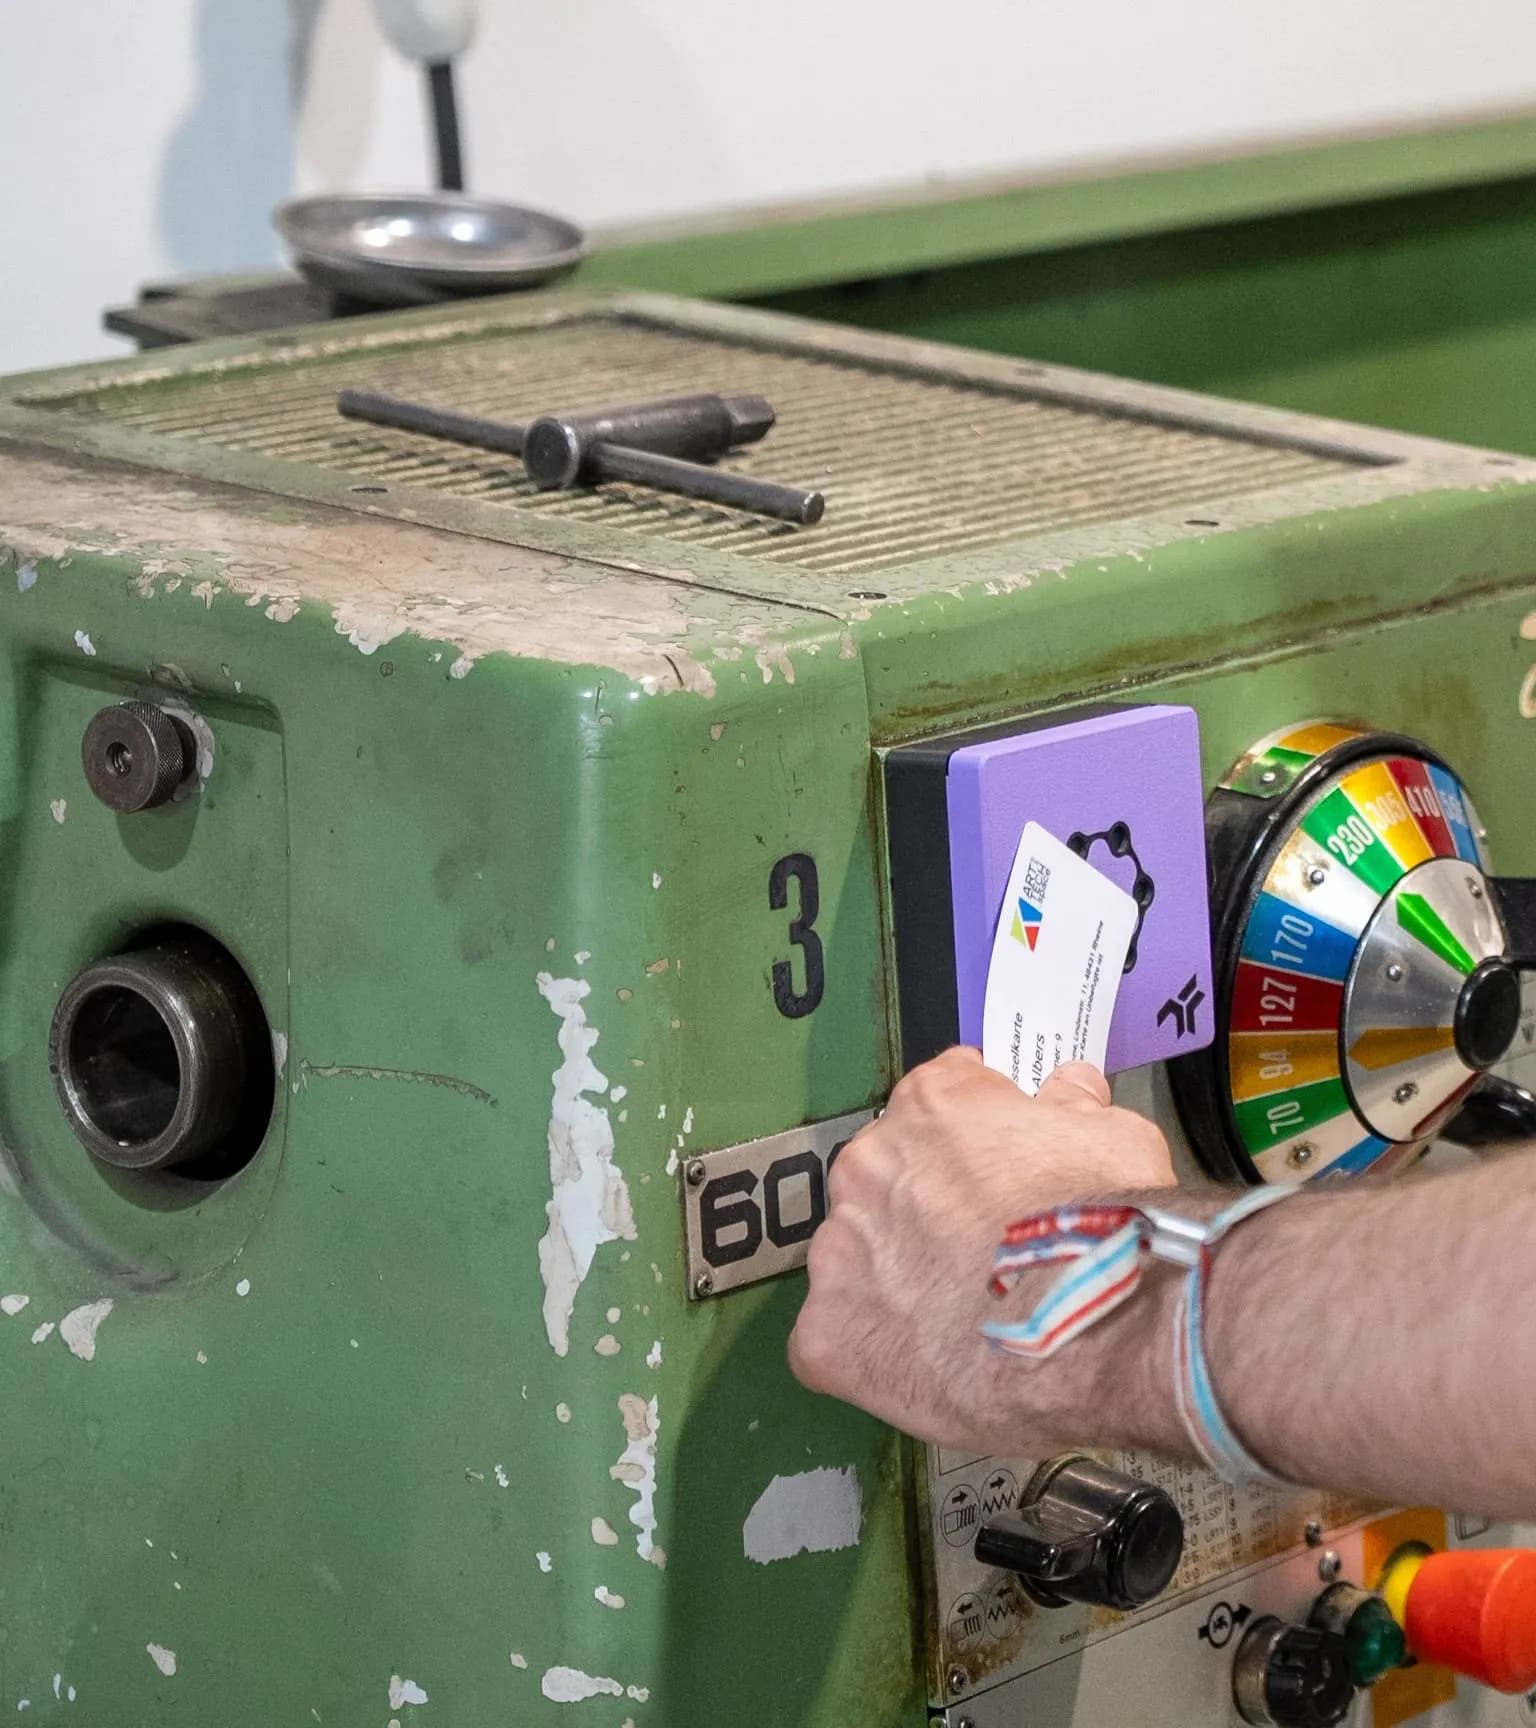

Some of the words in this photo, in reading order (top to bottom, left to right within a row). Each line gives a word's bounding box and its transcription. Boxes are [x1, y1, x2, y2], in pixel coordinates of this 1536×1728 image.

[1365, 791, 1408, 832] 305
[1404, 785, 1441, 818] 410
[1327, 815, 1375, 866] 230
[1023, 861, 1037, 899] ART
[1030, 863, 1046, 901] TECH
[1038, 868, 1051, 904] space
[768, 852, 825, 1019] 3
[1271, 913, 1314, 964] 170
[1259, 976, 1298, 1026] 127
[1012, 1011, 1023, 1083] sselkarte
[1032, 1032, 1045, 1089] Albers
[1258, 1048, 1294, 1080] 94
[1266, 1100, 1305, 1135] 70
[700, 1138, 852, 1268] 60
